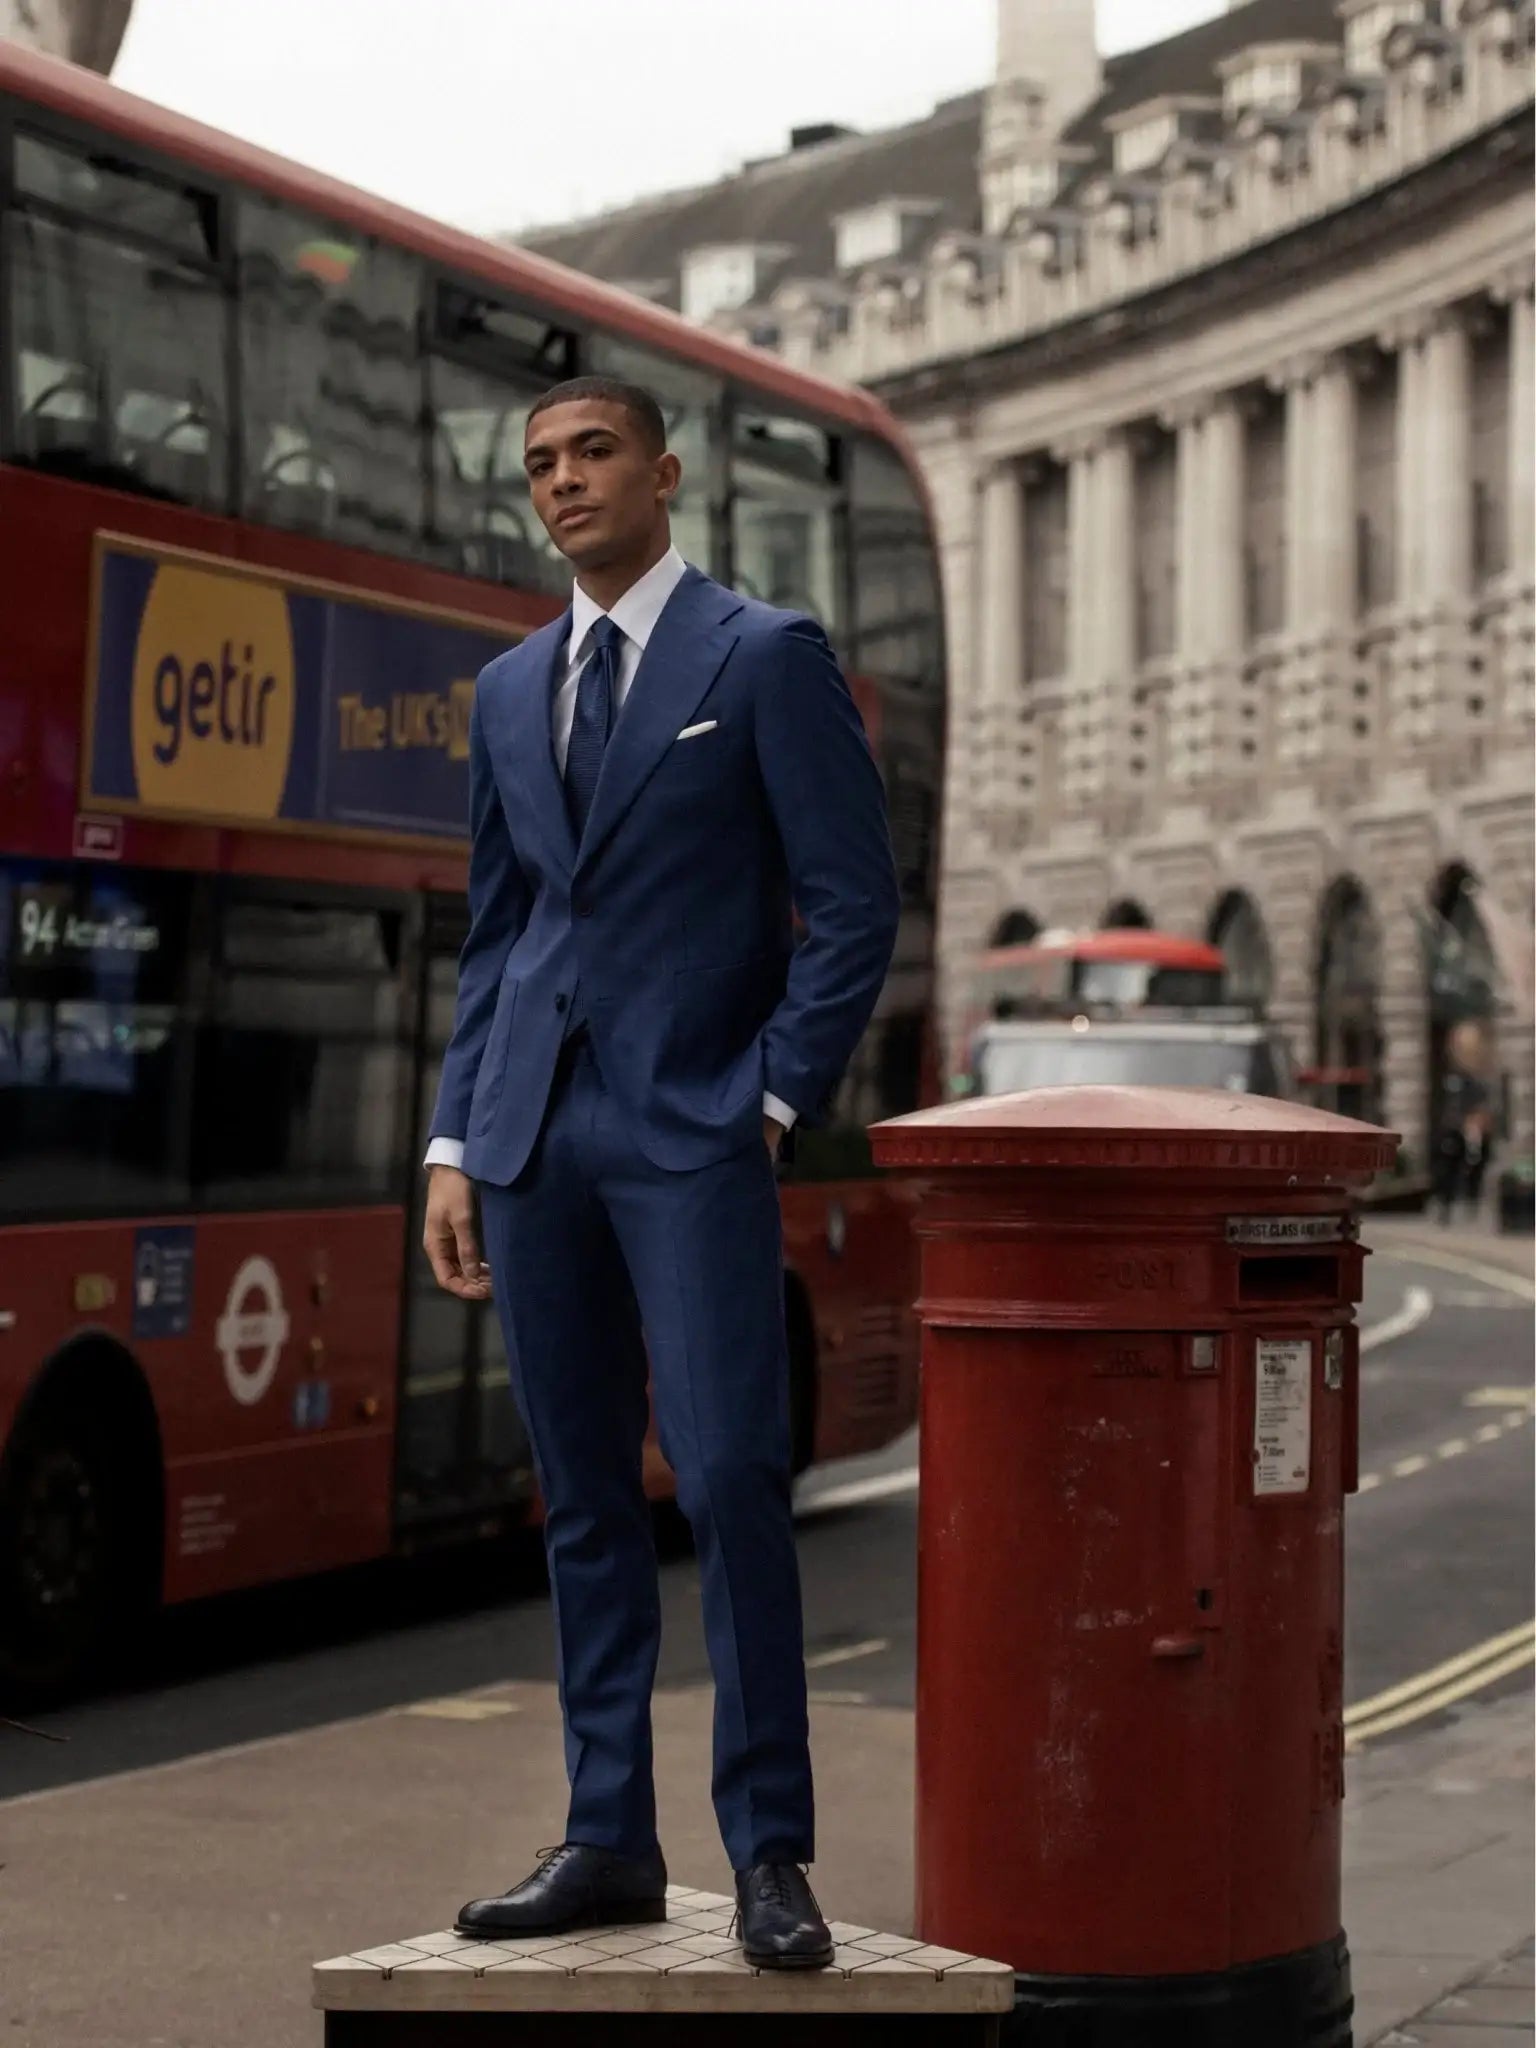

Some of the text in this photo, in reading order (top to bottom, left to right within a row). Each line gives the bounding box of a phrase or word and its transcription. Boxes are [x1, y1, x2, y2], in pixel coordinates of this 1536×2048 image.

[152, 639, 277, 767] getir
[338, 693, 385, 751] The
[20, 899, 58, 956] 94
[1240, 1223, 1267, 1237] FIRST
[1269, 1223, 1298, 1237] CLASS
